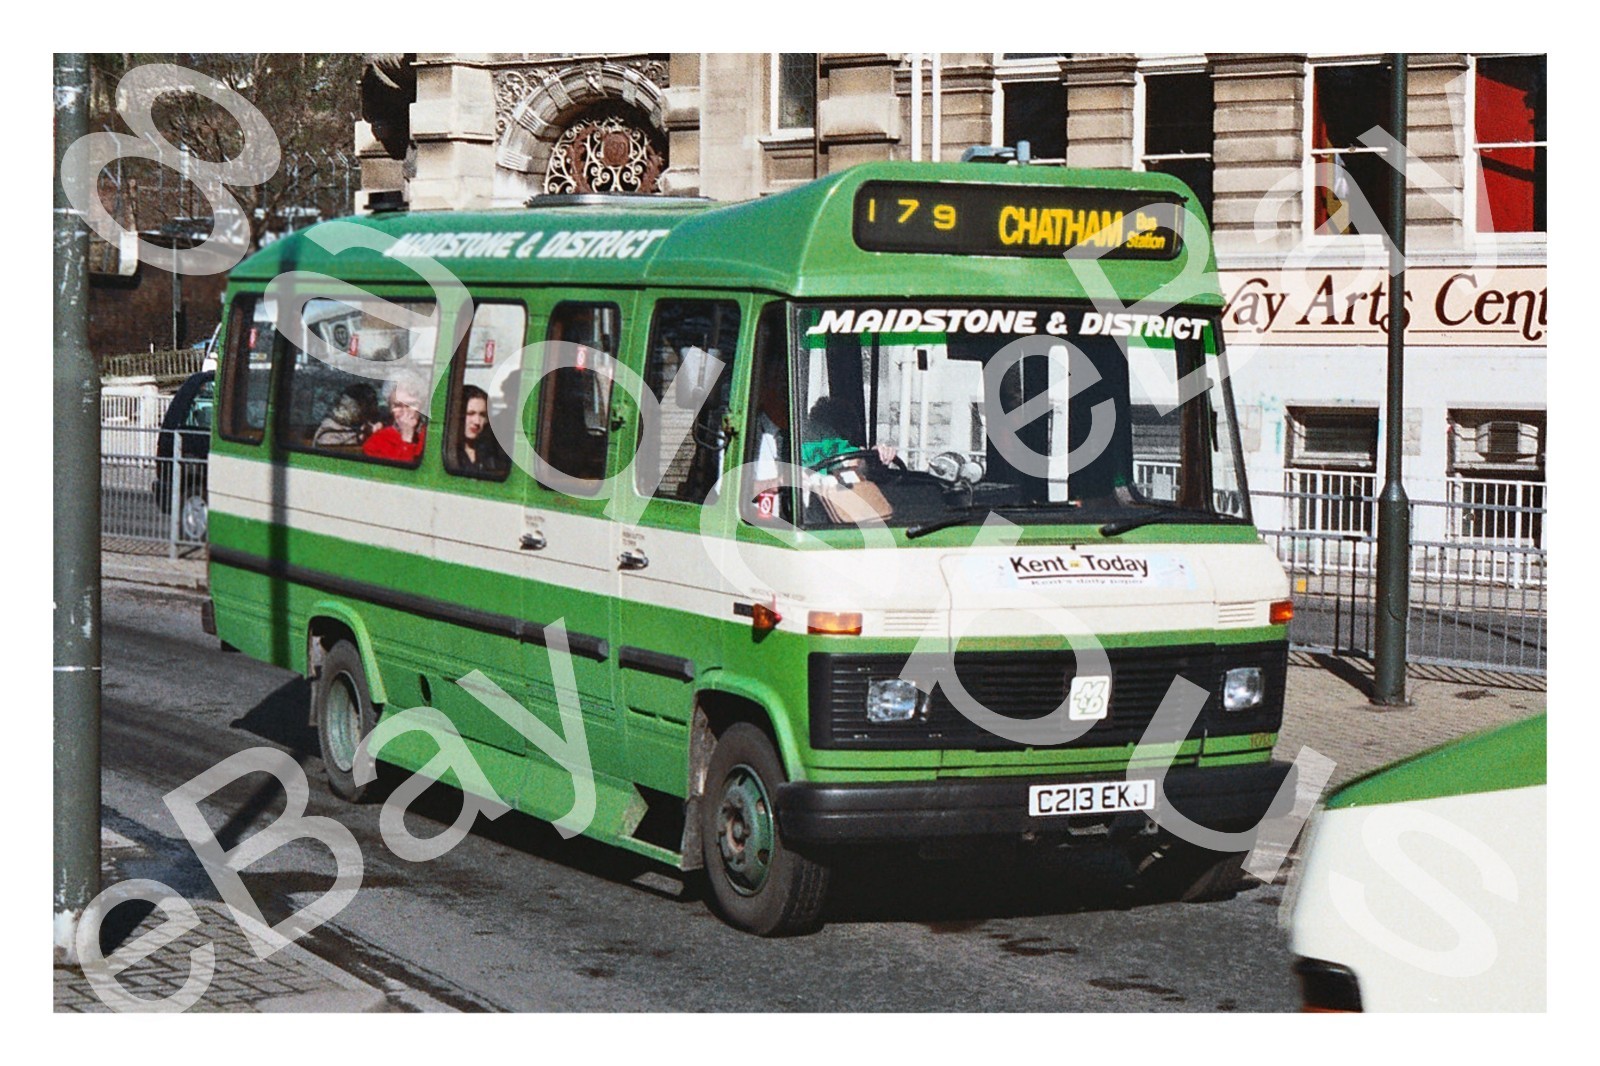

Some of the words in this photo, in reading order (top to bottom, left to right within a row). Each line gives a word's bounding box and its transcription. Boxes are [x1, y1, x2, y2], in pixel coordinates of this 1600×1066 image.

[999, 206, 1124, 247] CHATHAM
[1136, 212, 1157, 231] Bus
[383, 231, 525, 258] MAIDSTONE
[515, 231, 543, 258] &
[537, 229, 670, 258] DISTRICT
[1126, 232, 1165, 249] Station
[806, 308, 1037, 335] MAIDSTONE
[1046, 312, 1068, 334] &
[1079, 312, 1209, 340] DISTRICT
[1009, 555, 1069, 574] Kent
[1080, 555, 1149, 577] Today
[1037, 787, 1094, 813] C213
[1101, 783, 1148, 807] EKJ
